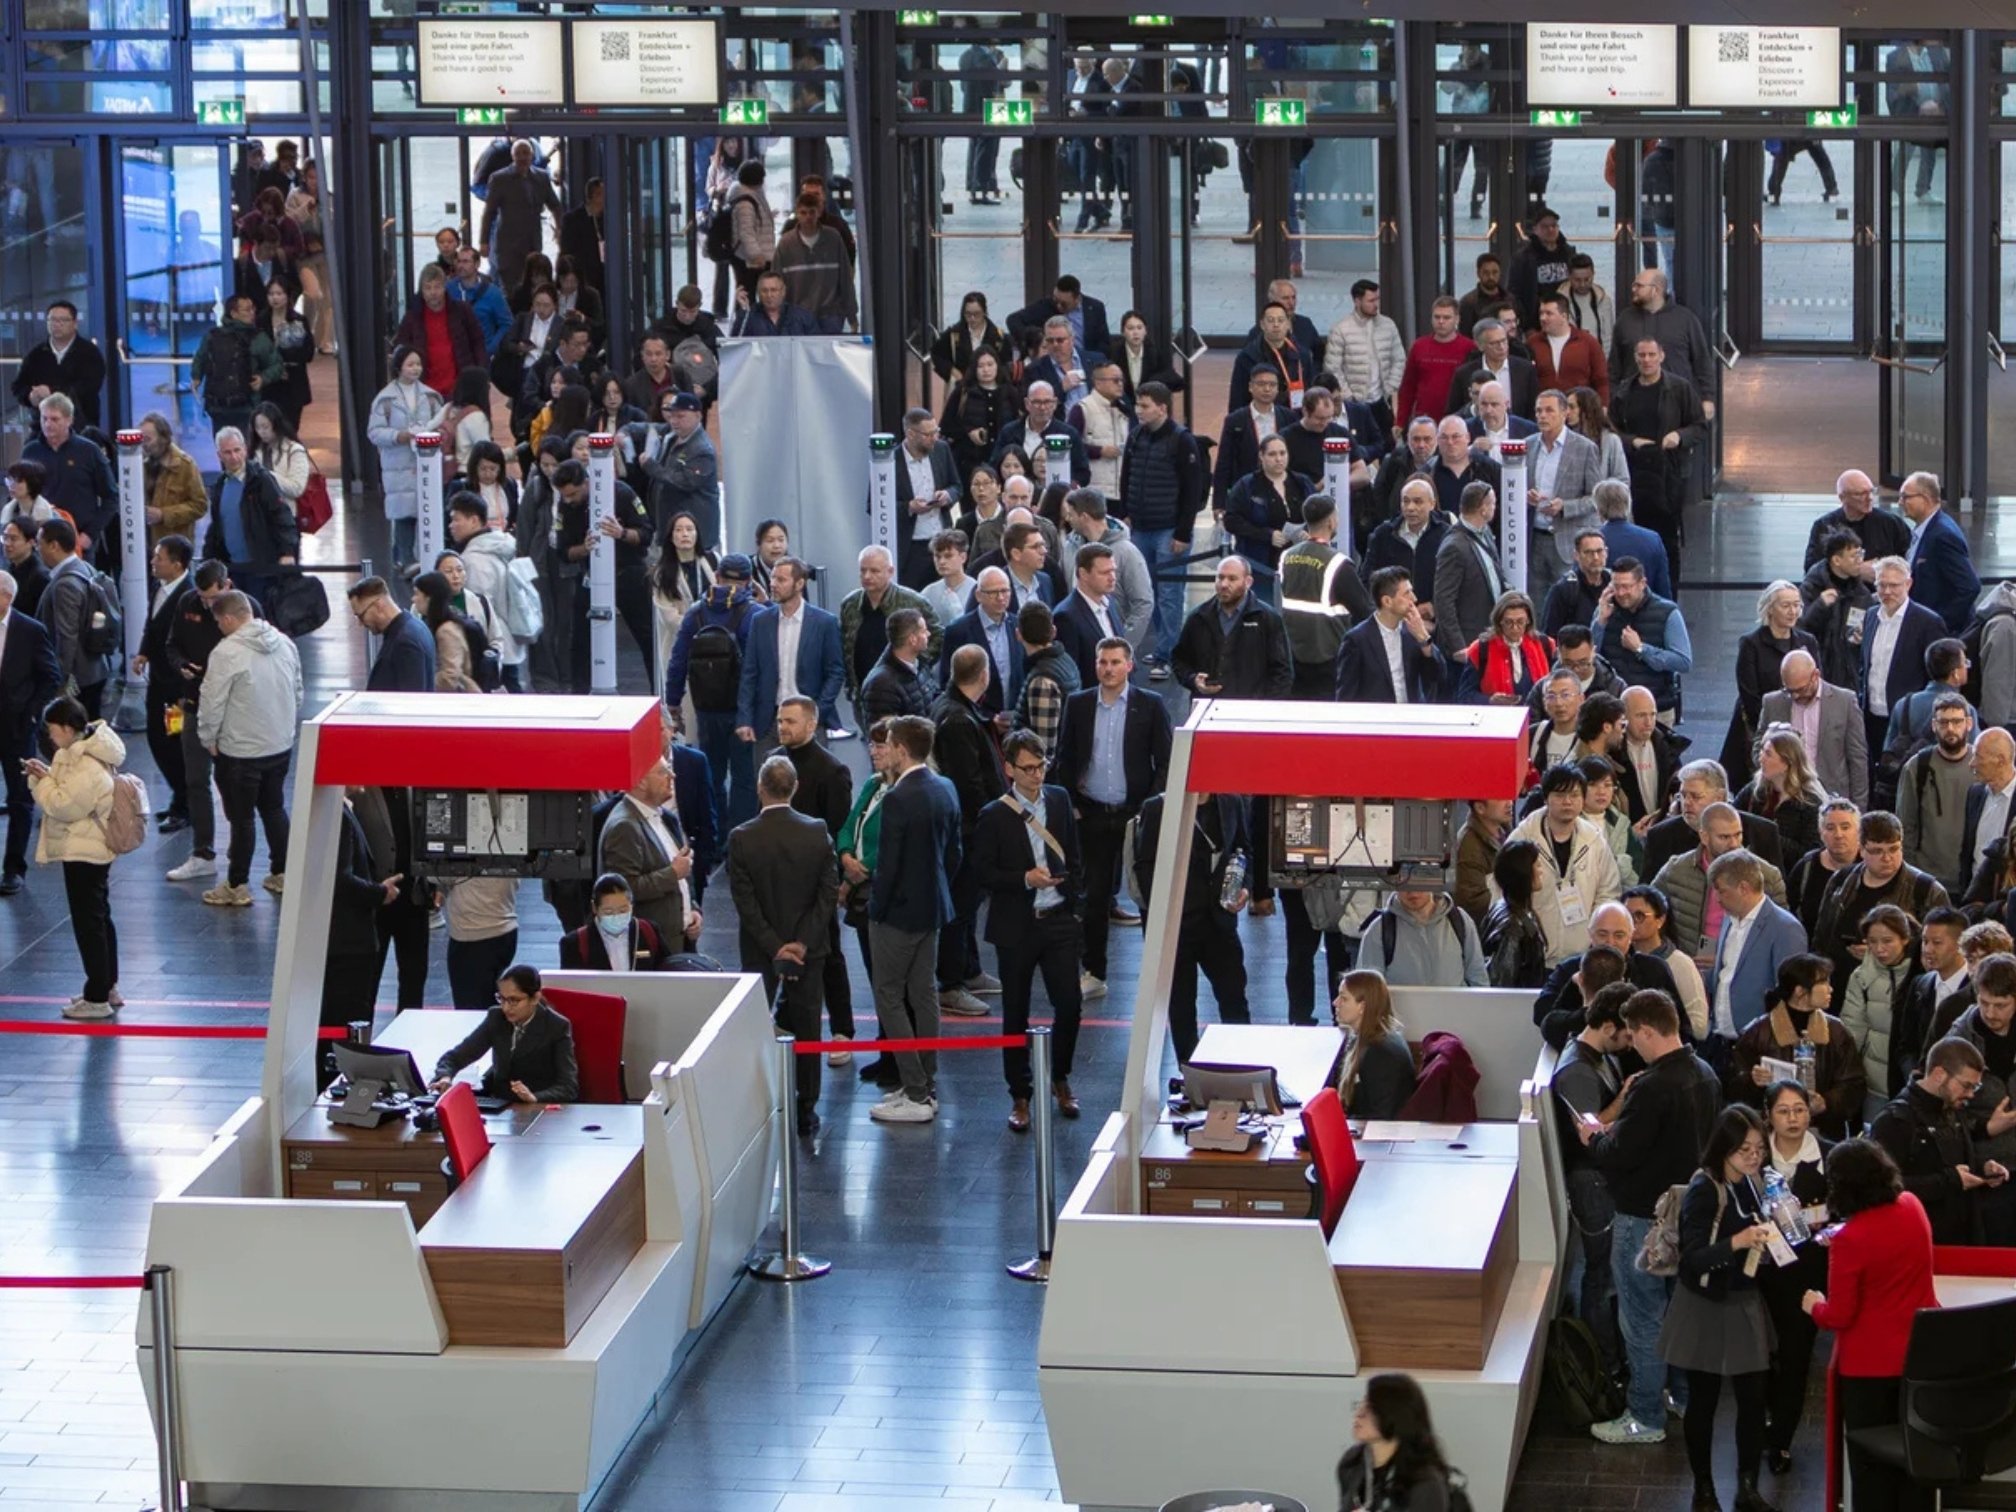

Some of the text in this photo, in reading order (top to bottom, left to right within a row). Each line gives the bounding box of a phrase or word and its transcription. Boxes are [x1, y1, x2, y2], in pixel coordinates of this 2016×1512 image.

[1610, 31, 1643, 39] Besuch
[639, 41, 683, 50] Entdecken
[1580, 43, 1600, 51] gute
[1540, 53, 1565, 61] Thank
[640, 64, 674, 72] Discover
[1587, 66, 1608, 74] good
[1759, 66, 1795, 74] Discover
[640, 76, 683, 84] Experience
[1759, 78, 1804, 87] Experience
[640, 86, 676, 94] Frankfurt
[1759, 88, 1797, 96] Frankfurt
[122, 465, 134, 555] WELCOME
[421, 464, 432, 554] WELCOME
[1507, 479, 1517, 570] WELCOME
[1285, 555, 1324, 570] SECURITY
[296, 1151, 312, 1163] 88
[1154, 1168, 1172, 1180] 86
